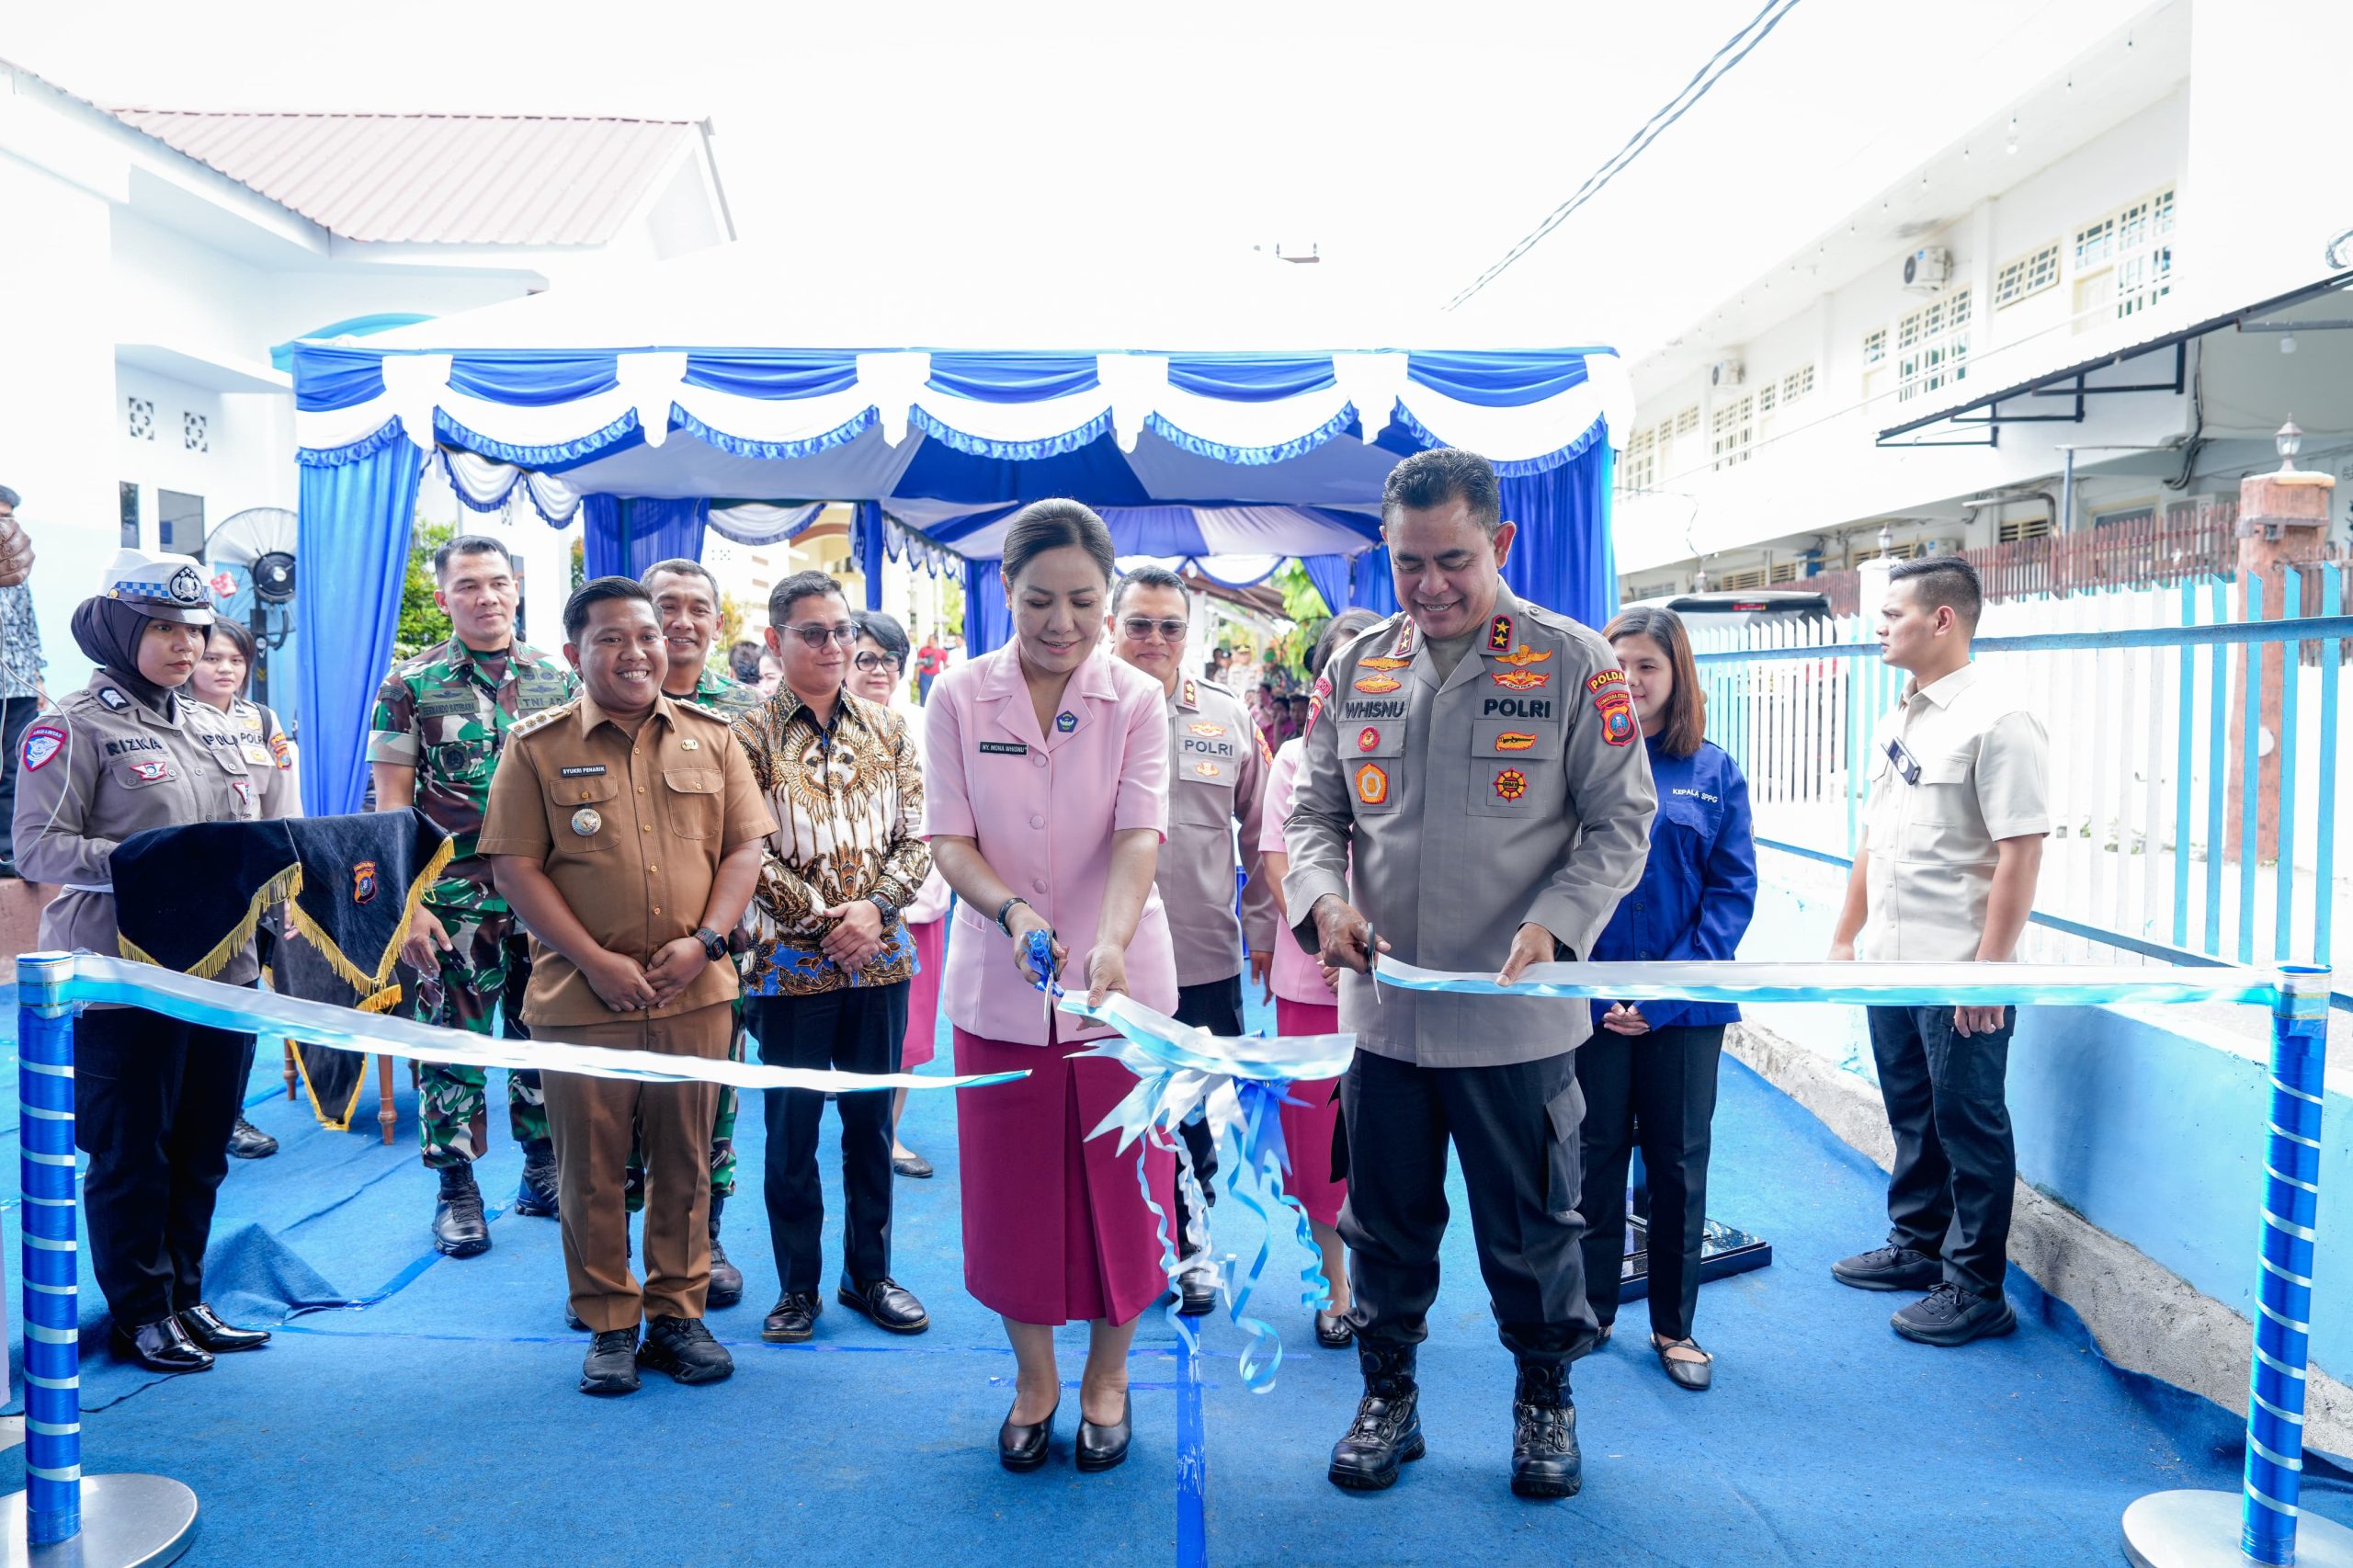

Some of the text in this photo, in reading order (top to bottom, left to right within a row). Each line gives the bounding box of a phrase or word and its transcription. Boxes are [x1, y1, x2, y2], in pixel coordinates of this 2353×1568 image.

[1590, 671, 1625, 690] POLDA
[523, 699, 544, 707] TNI
[1345, 700, 1404, 719] WHISNU
[1483, 699, 1551, 719] POLRI
[105, 737, 163, 756] RIZKA
[1184, 739, 1233, 756] POLRI
[1672, 788, 1718, 803] KEPALA SPPG
